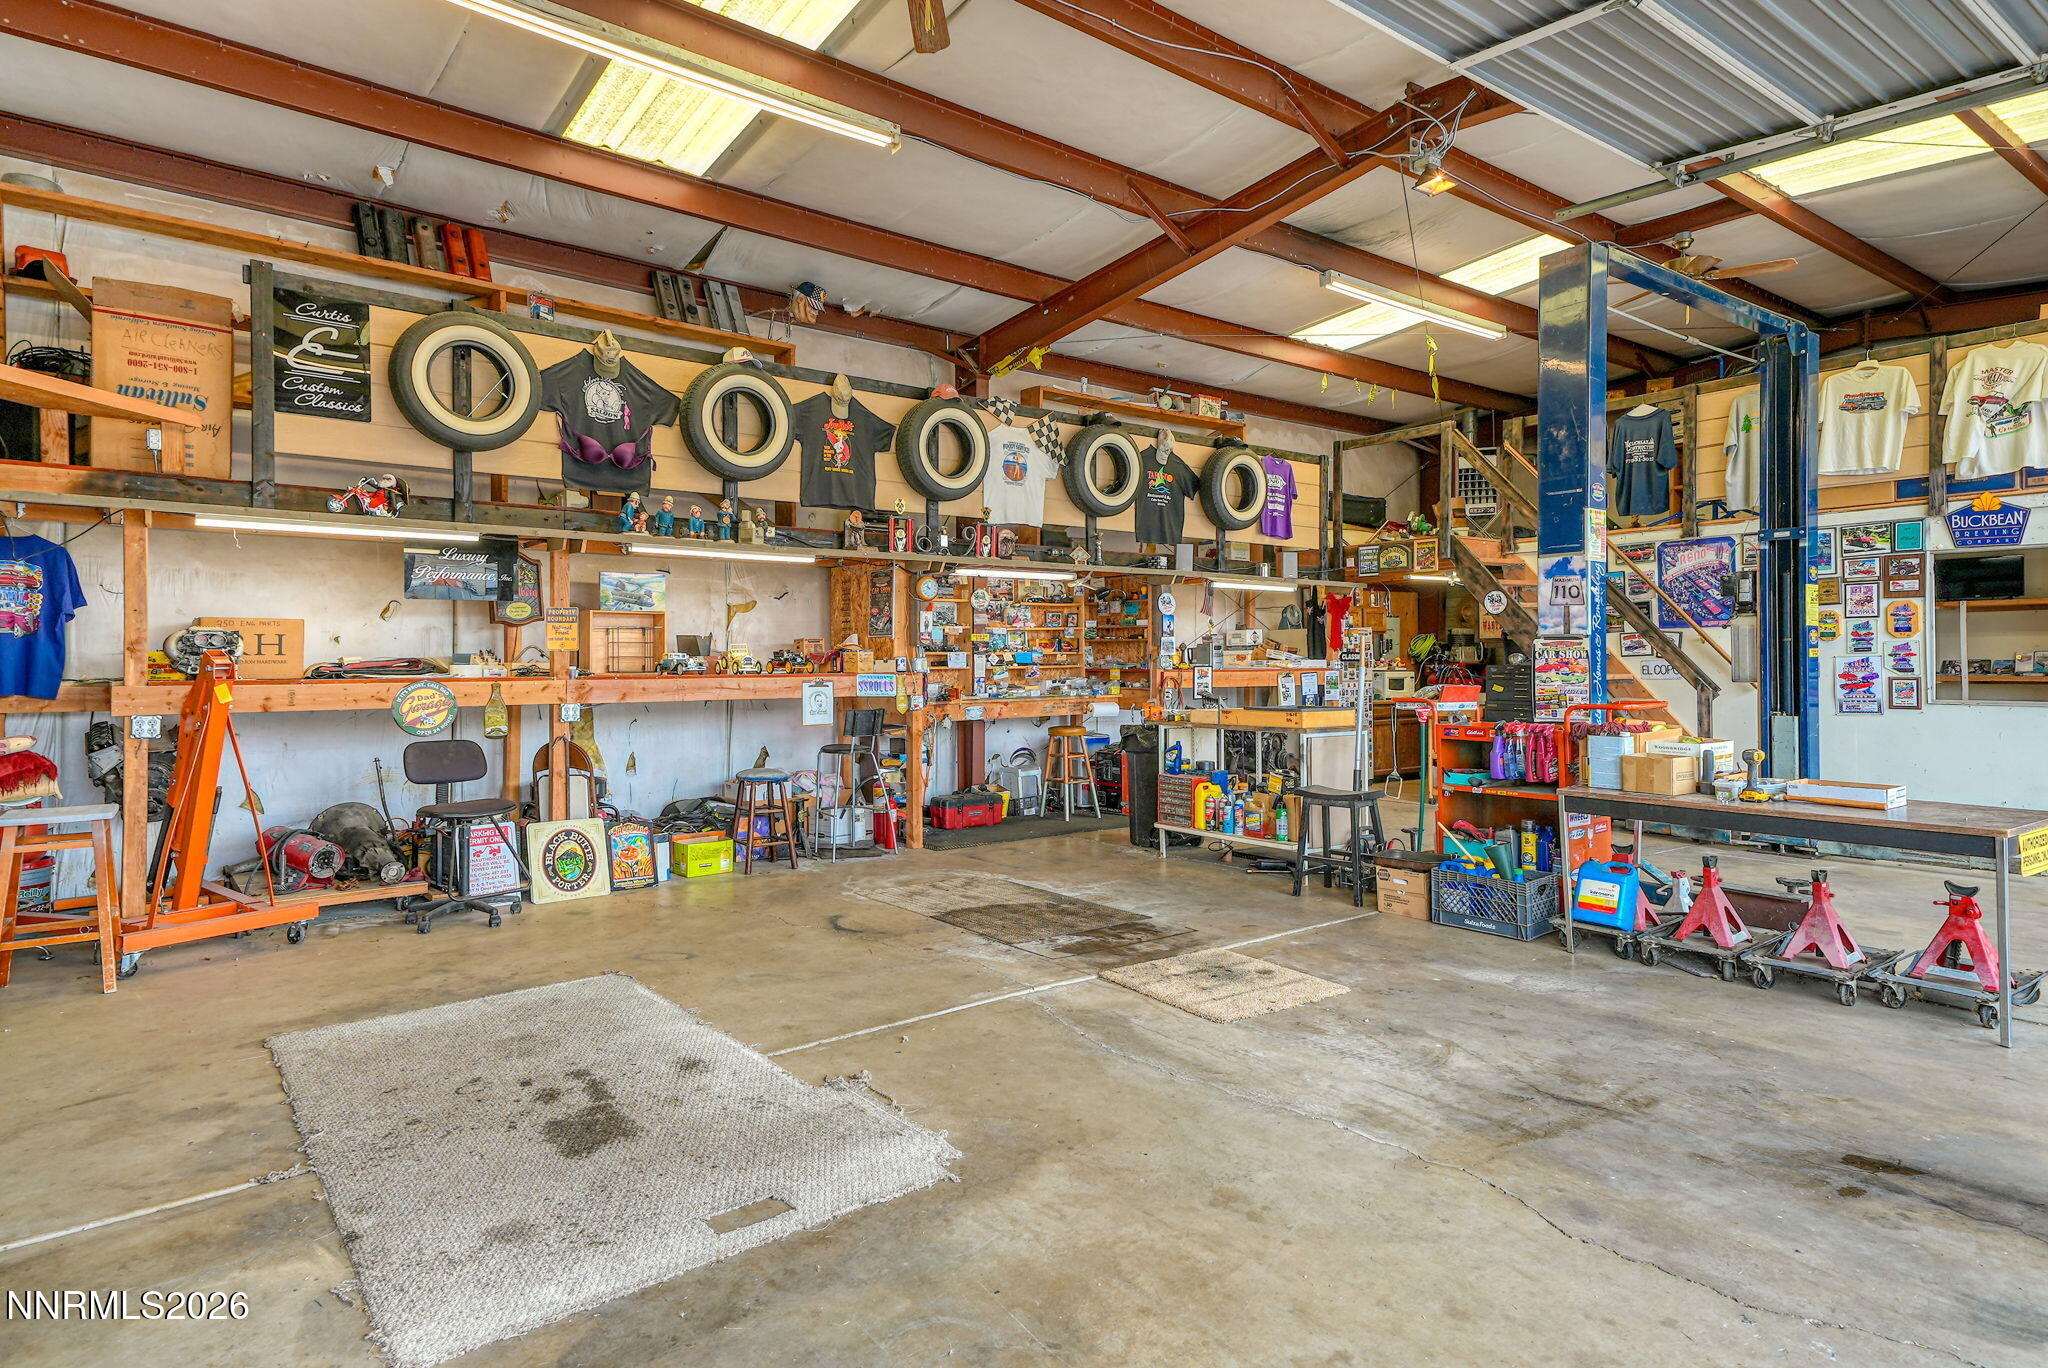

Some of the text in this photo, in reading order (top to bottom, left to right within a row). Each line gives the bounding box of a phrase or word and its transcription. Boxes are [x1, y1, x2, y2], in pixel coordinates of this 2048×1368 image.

[295, 302, 353, 323] Curtis
[1982, 366, 2014, 376] MASTER
[282, 376, 343, 396] Custom
[116, 383, 208, 412] Sullivan
[294, 393, 364, 413] Classics
[591, 407, 618, 418] SALOON
[1951, 511, 2023, 528] BUCKBEAN
[1955, 528, 2020, 538] BREWING
[438, 547, 489, 563] Luxury
[411, 565, 497, 584] Performance,
[1554, 585, 1580, 600] 110
[1535, 650, 1588, 659] CAR SHOW
[1642, 665, 1652, 675] EL
[858, 681, 894, 692] SSROLLS
[417, 692, 441, 702] Dad's
[399, 697, 455, 722] Garage
[470, 830, 494, 838] ARKING
[545, 832, 569, 866] BLACK
[570, 831, 594, 863] BUTTE
